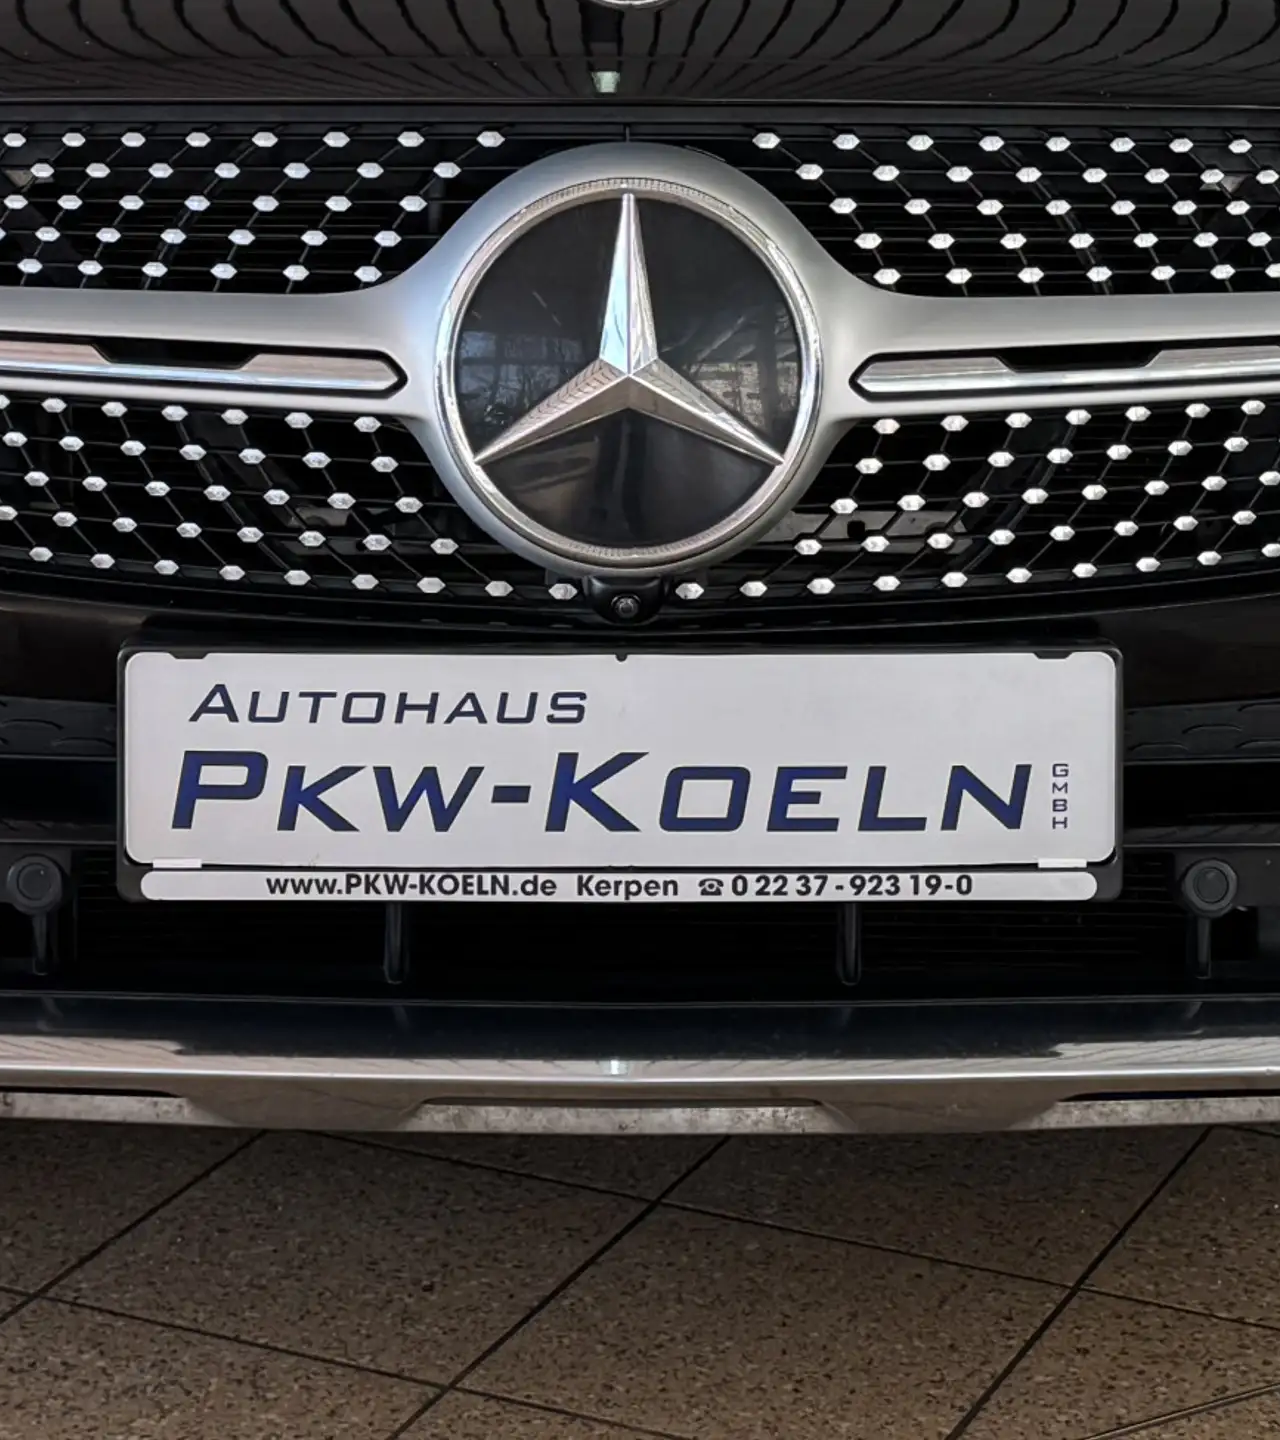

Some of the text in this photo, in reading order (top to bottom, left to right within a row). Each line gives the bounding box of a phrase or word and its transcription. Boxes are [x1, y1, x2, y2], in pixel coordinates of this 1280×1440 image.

[189, 683, 588, 725] AUTOHAUS
[171, 750, 1033, 833] PKW-KOELN
[266, 873, 557, 897] www.PKW-KOELN.de
[576, 874, 679, 901] Kerpen
